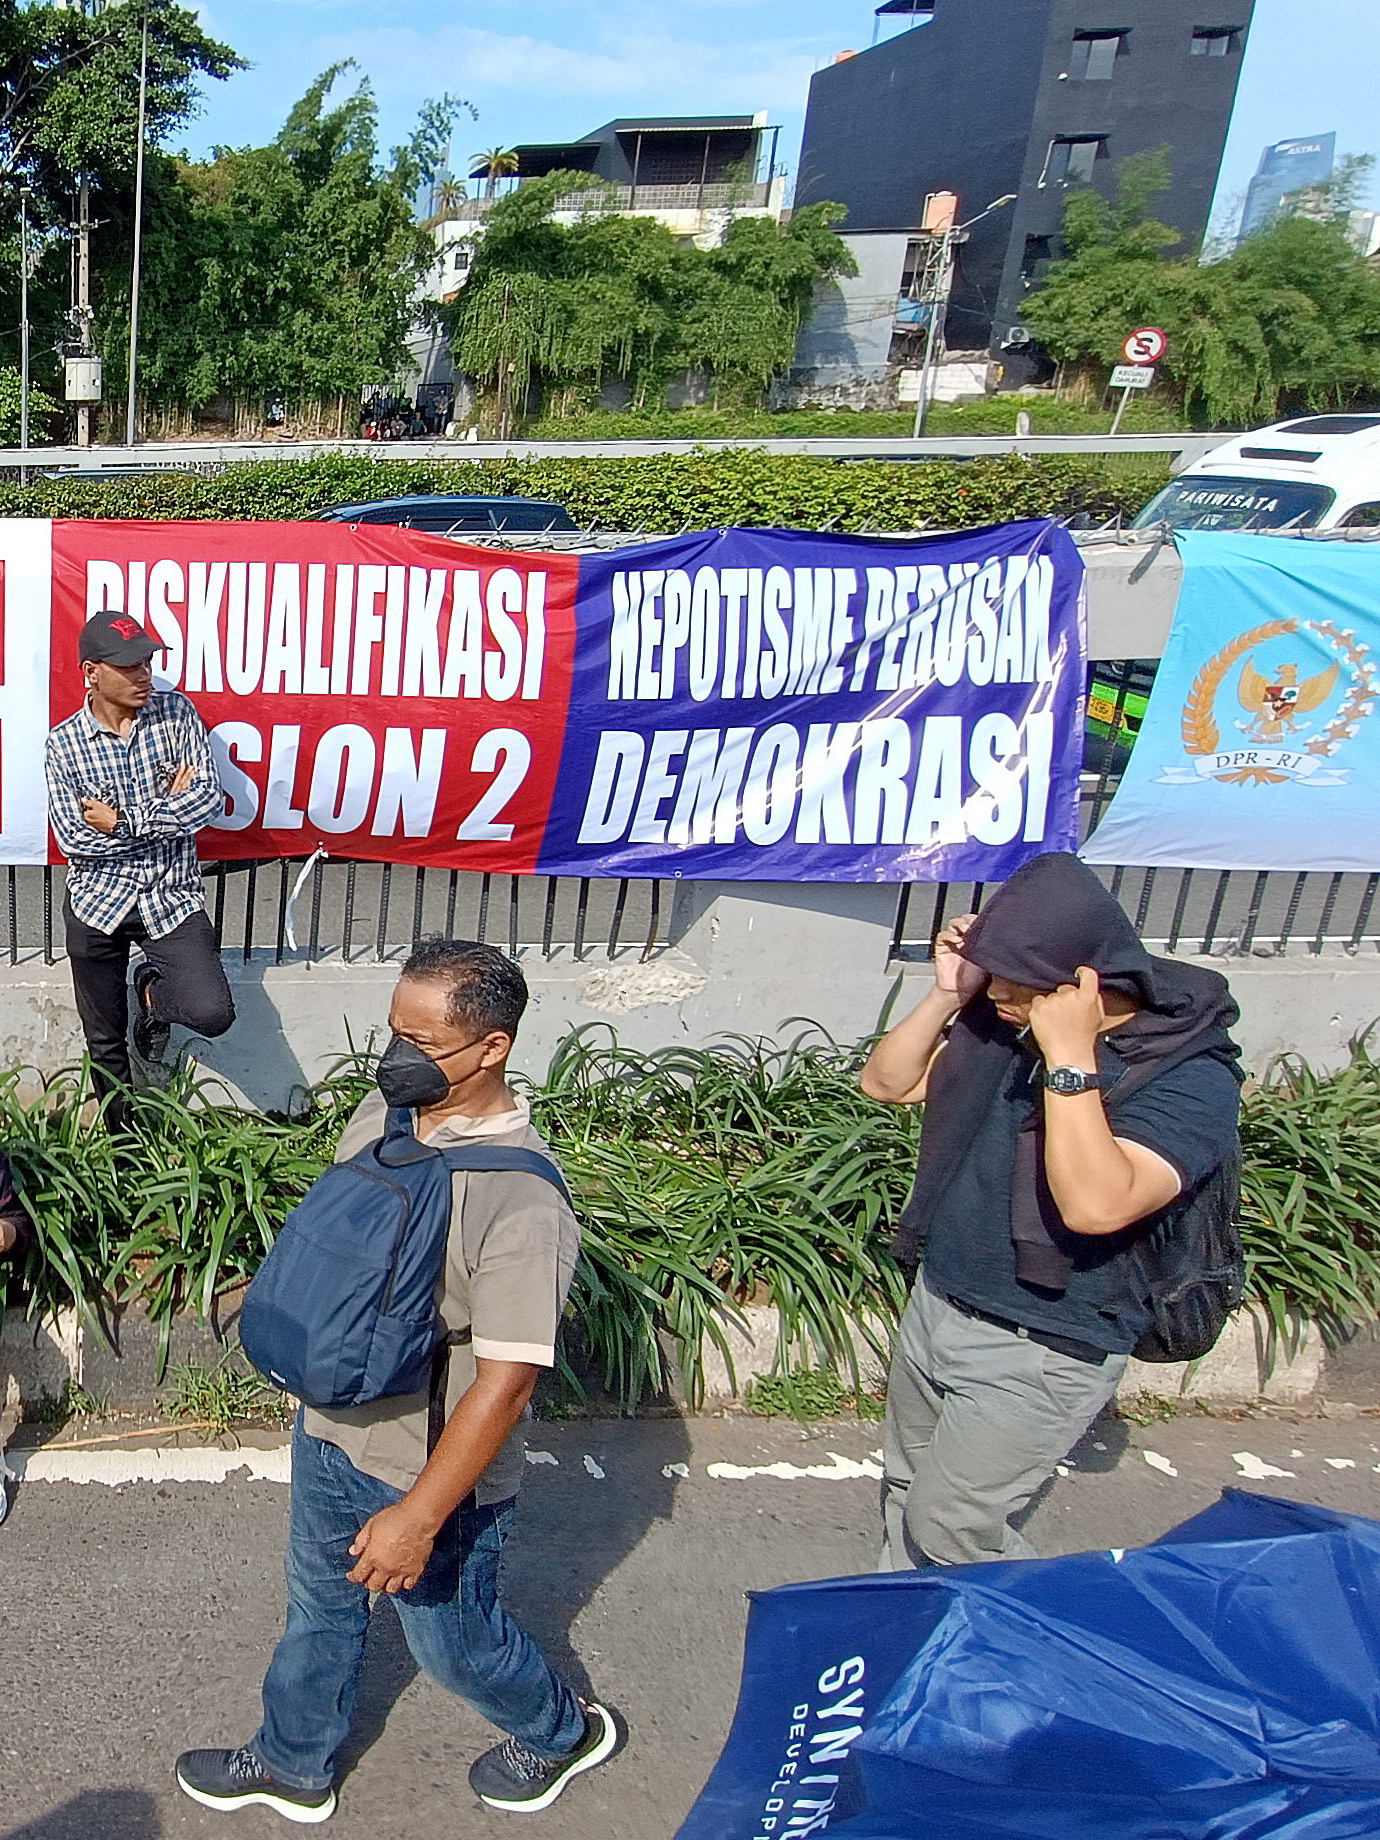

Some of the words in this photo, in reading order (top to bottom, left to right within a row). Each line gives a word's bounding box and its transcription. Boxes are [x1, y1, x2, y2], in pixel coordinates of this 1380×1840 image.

[1176, 491, 1278, 512] PARIWISATA
[607, 565, 856, 700] NEPOTISME
[208, 720, 448, 838] SLON
[456, 727, 531, 842] 2
[576, 711, 1055, 846] DEMOKRASI
[1216, 752, 1258, 768] DPR
[1276, 753, 1302, 769] RI
[754, 1703, 809, 1840] DEVELOP
